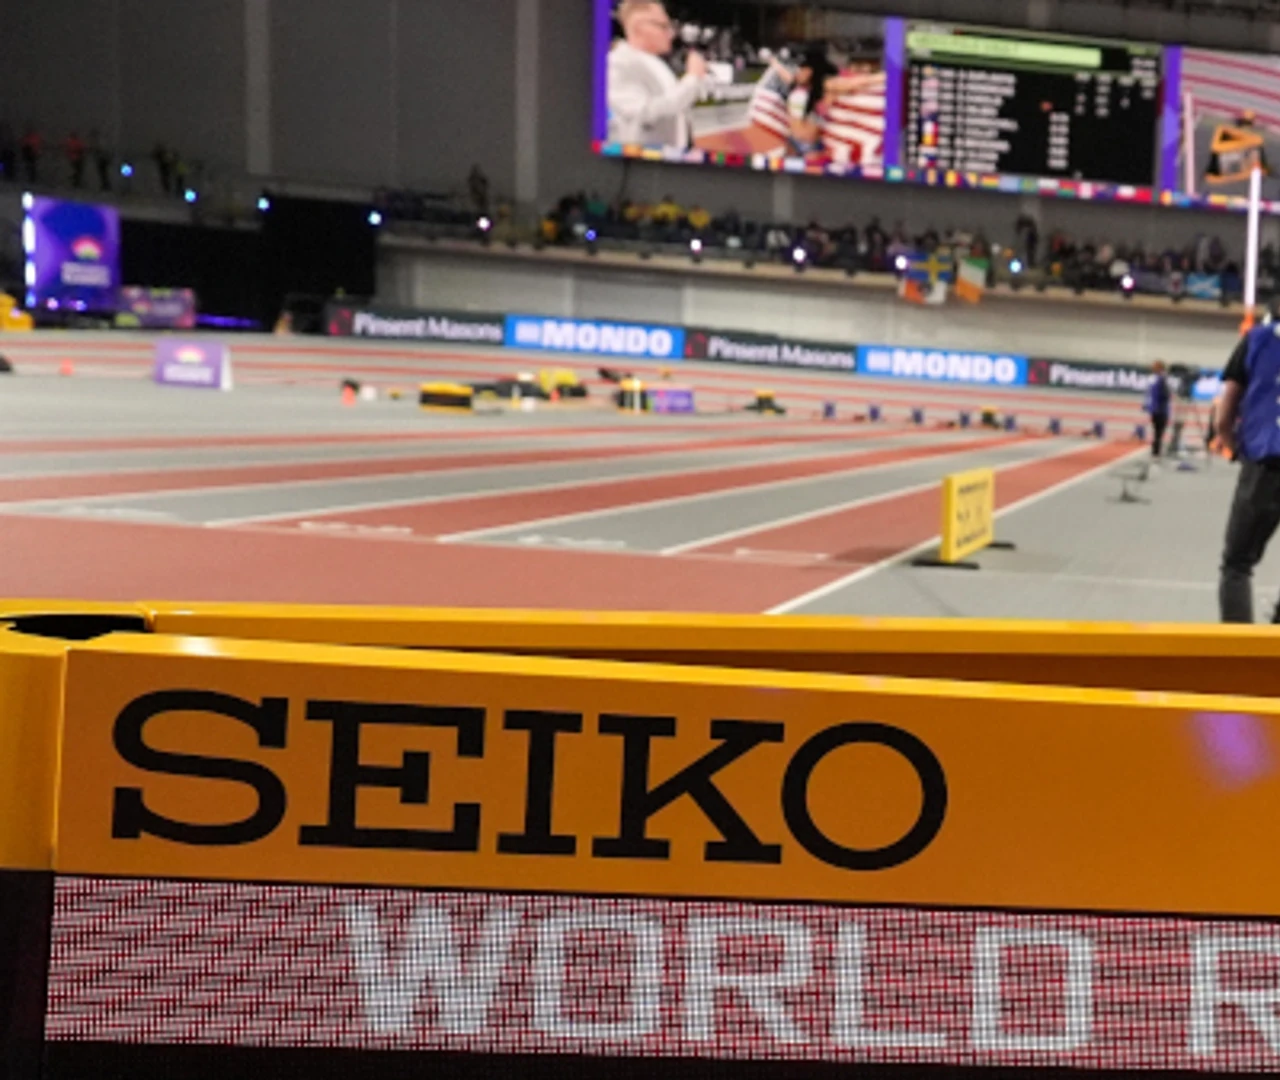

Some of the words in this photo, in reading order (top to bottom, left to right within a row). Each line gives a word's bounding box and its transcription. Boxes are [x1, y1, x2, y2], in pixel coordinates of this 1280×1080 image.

[541, 321, 673, 356] MONDO
[892, 350, 1017, 383] MONDO
[110, 688, 949, 872] SEIKO
[346, 901, 1095, 1052] WORLD
